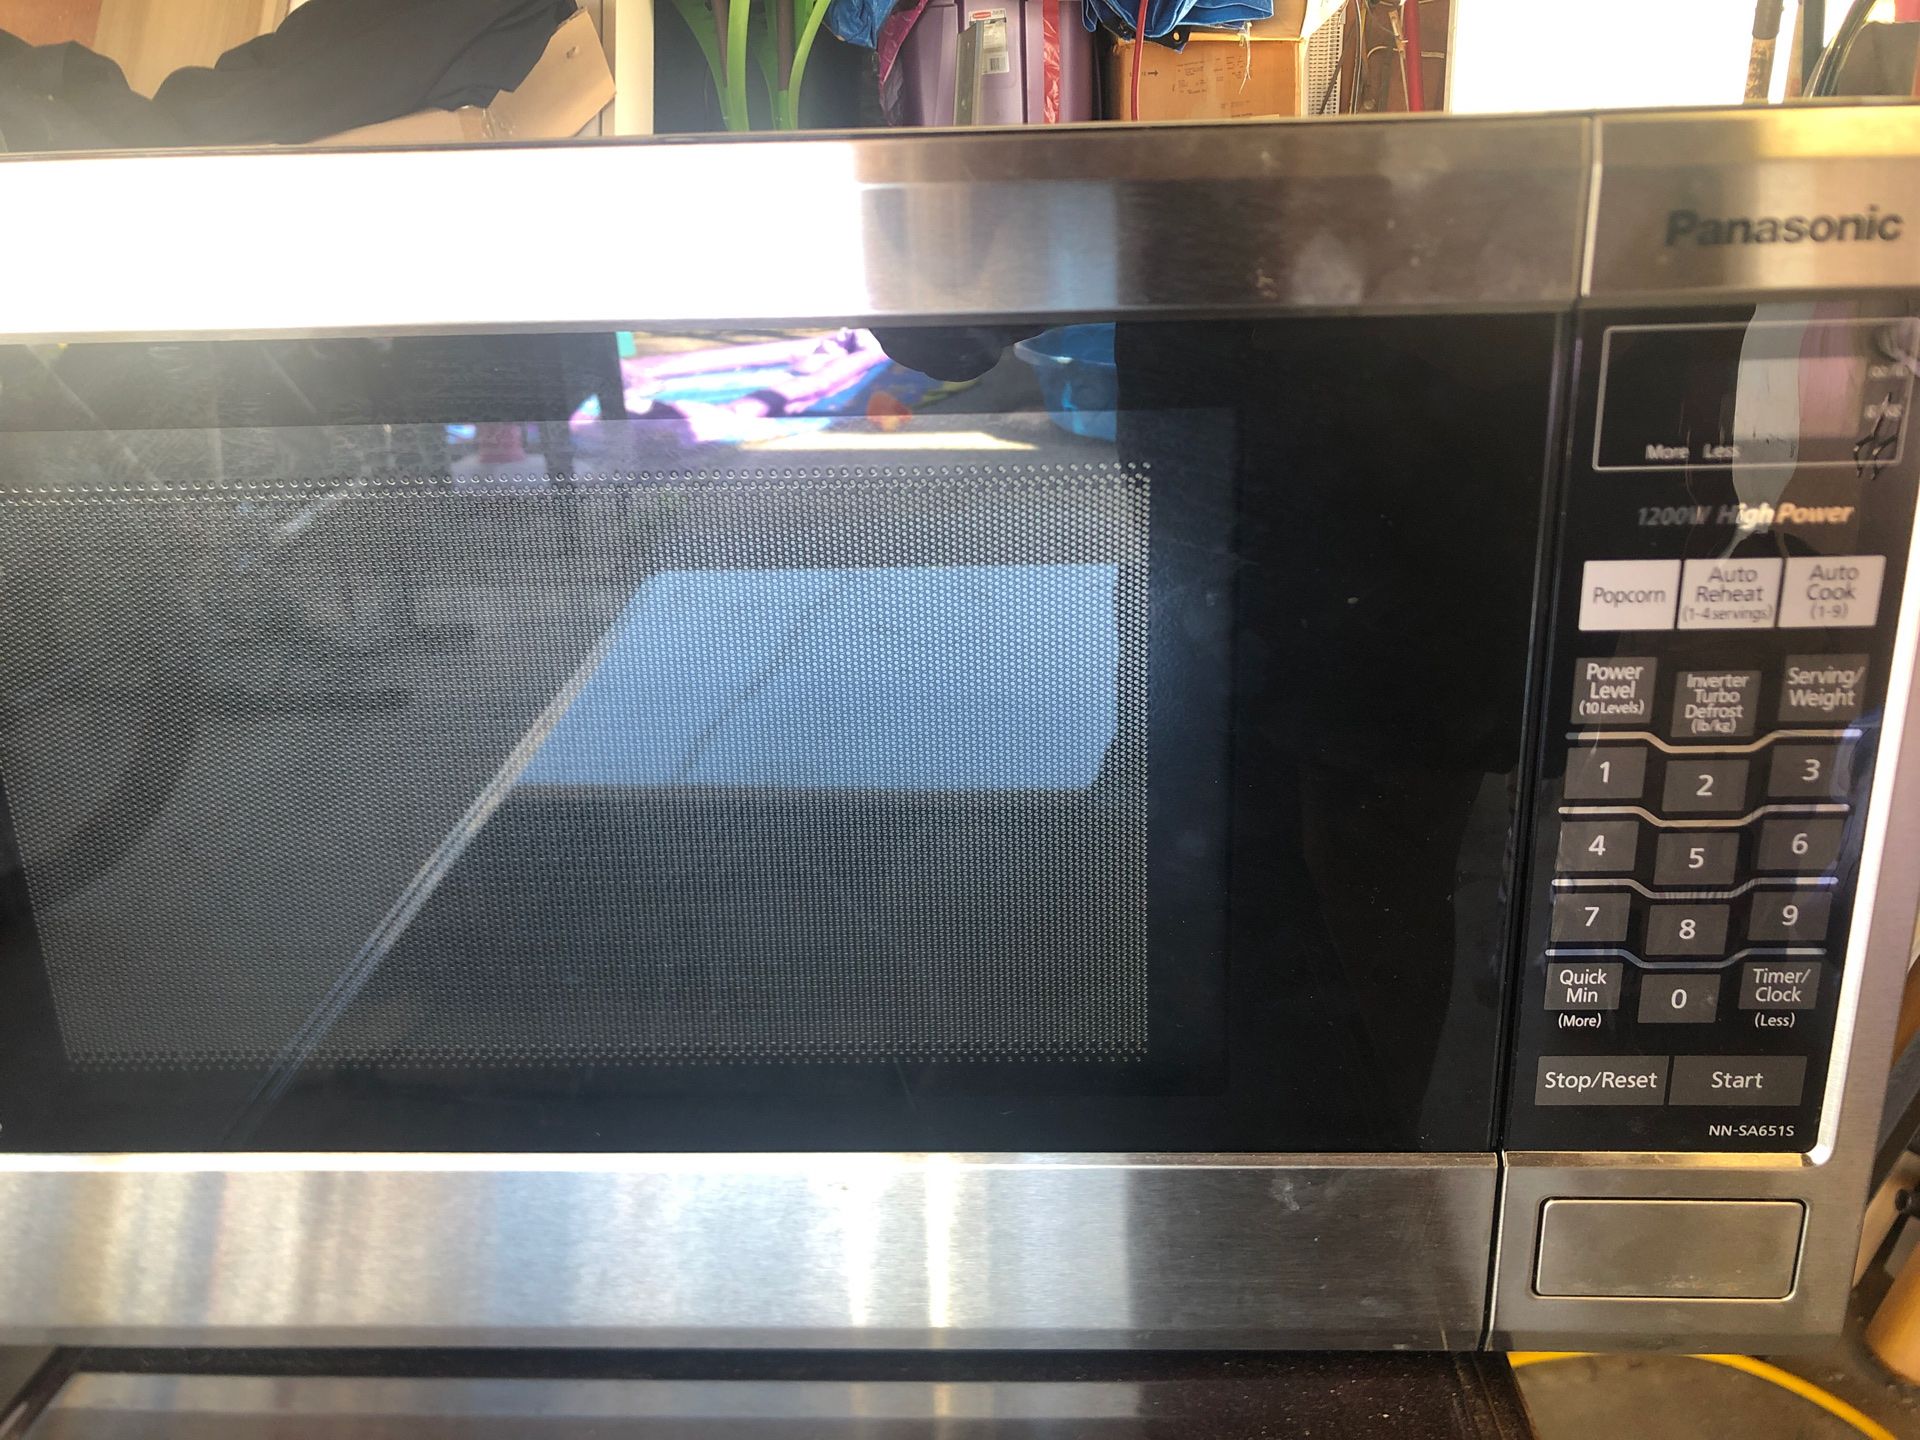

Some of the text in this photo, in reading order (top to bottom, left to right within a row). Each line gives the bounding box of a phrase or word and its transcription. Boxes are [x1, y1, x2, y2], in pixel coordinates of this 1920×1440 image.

[1665, 204, 1904, 247] Panasonic
[1646, 443, 1740, 460] More Less
[1638, 502, 1855, 531] 1200W High Power
[1709, 566, 1758, 583] Auto
[1809, 564, 1860, 581] Auto
[1593, 587, 1667, 608] Popcorn
[1695, 585, 1763, 602] Reheat
[1806, 583, 1856, 601] Cook
[1683, 605, 1773, 623] (1-4 servings)
[1810, 602, 1849, 619] (1-9)
[1586, 663, 1644, 681] Power
[1686, 673, 1750, 689] Inverter
[1788, 666, 1866, 689] Serving/
[1590, 681, 1636, 699] Level
[1694, 688, 1740, 704] Turbo
[1578, 700, 1645, 716] (10 Levels)
[1789, 689, 1856, 711] Weight
[1684, 703, 1744, 719] Defrost
[1690, 718, 1737, 735] (lb/kg)
[1600, 761, 1611, 784] 1
[1801, 758, 1821, 781] 3
[1695, 775, 1715, 797] 2
[1588, 834, 1607, 857] 4
[1791, 832, 1809, 855] 6
[1688, 847, 1706, 869] 5
[1584, 906, 1600, 927] 7
[1782, 904, 1799, 926] 9
[1679, 918, 1696, 940] 8
[1559, 969, 1607, 987] Quick
[1753, 968, 1811, 985] Timer/
[1566, 987, 1599, 1004] Min
[1671, 988, 1688, 1010] 0
[1755, 987, 1802, 1003] Clock
[1557, 1013, 1602, 1029] (More)
[1754, 1012, 1796, 1028] (Less)
[1544, 1070, 1658, 1093] Stop/Reset
[1711, 1070, 1764, 1089] Start
[1708, 1123, 1796, 1138] NN-SA651S
